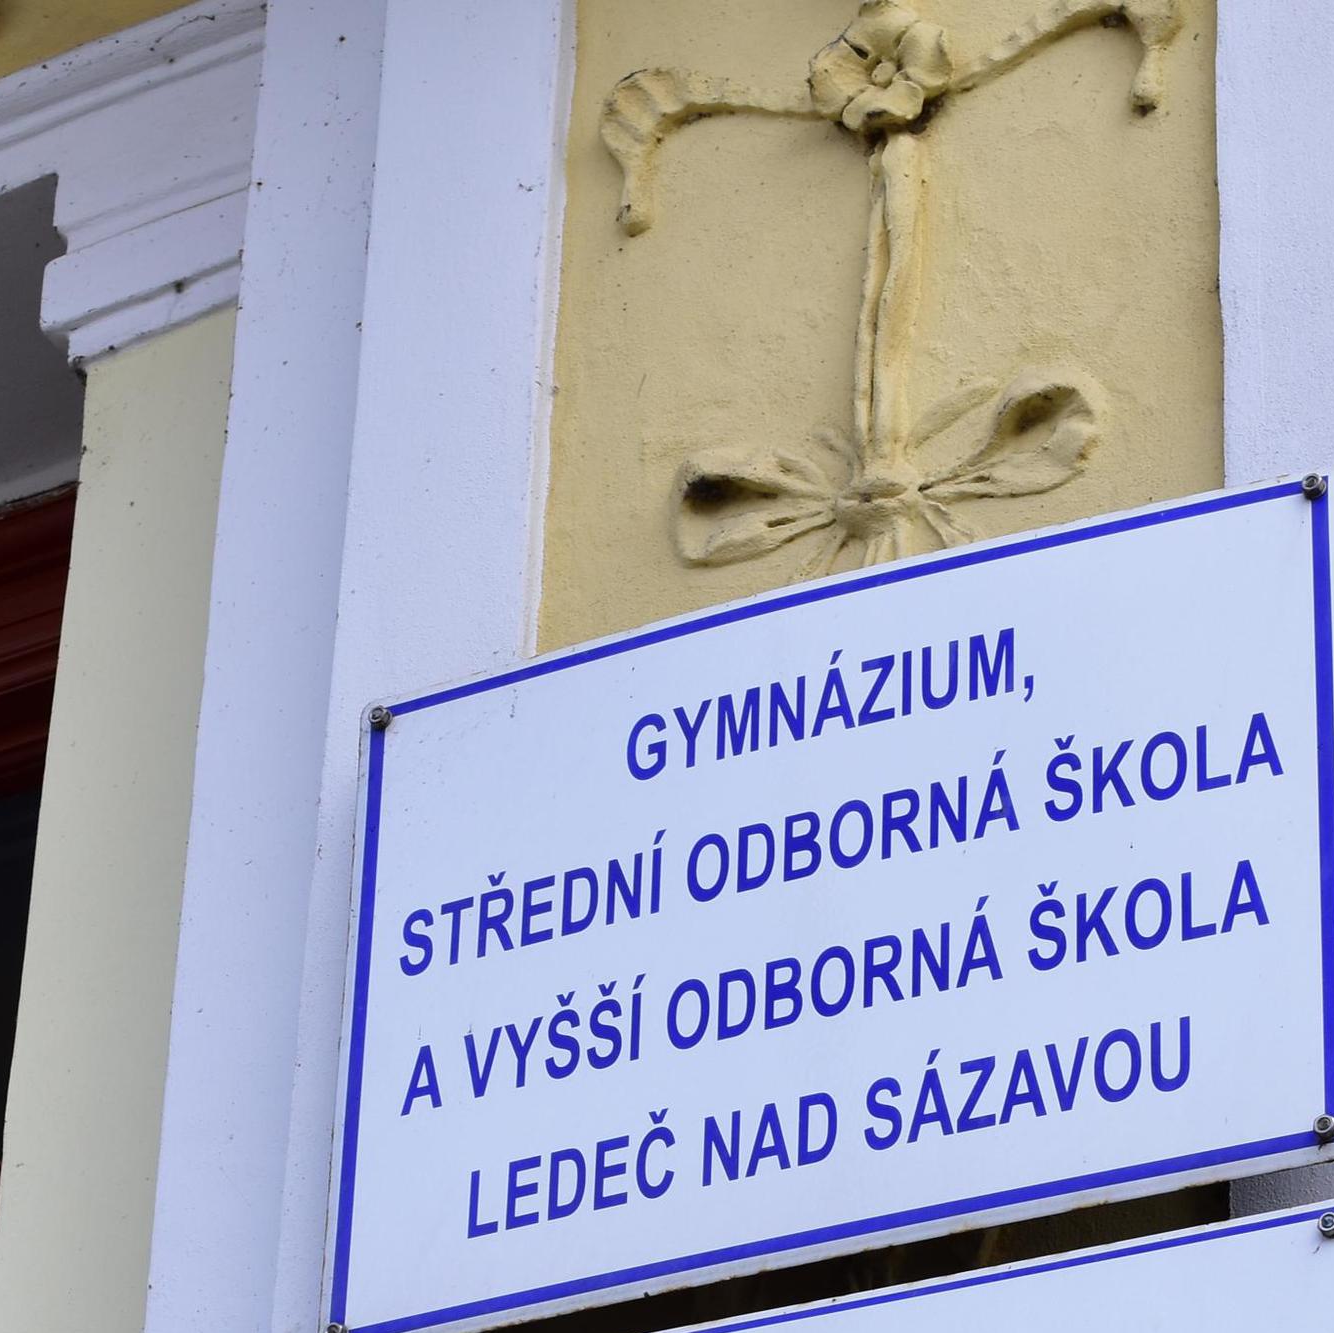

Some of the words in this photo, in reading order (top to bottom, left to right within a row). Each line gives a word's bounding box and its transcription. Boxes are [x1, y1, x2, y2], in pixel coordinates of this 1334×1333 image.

[625, 627, 1035, 781] GYMNÁZIUM,
[399, 829, 667, 977] STŘEDNÍ
[686, 749, 1021, 903] ODBORNÁ
[1044, 712, 1285, 823] ŠKOLA
[400, 1044, 443, 1117] A
[463, 974, 645, 1099] VYŠŠÍ
[666, 895, 1004, 1051] ODBORNÁ
[1027, 859, 1271, 972] ŠKOLA
[466, 1107, 677, 1239] LEDEČ
[701, 1092, 838, 1187] NAD
[863, 1015, 1192, 1152] SÁZAVOU
